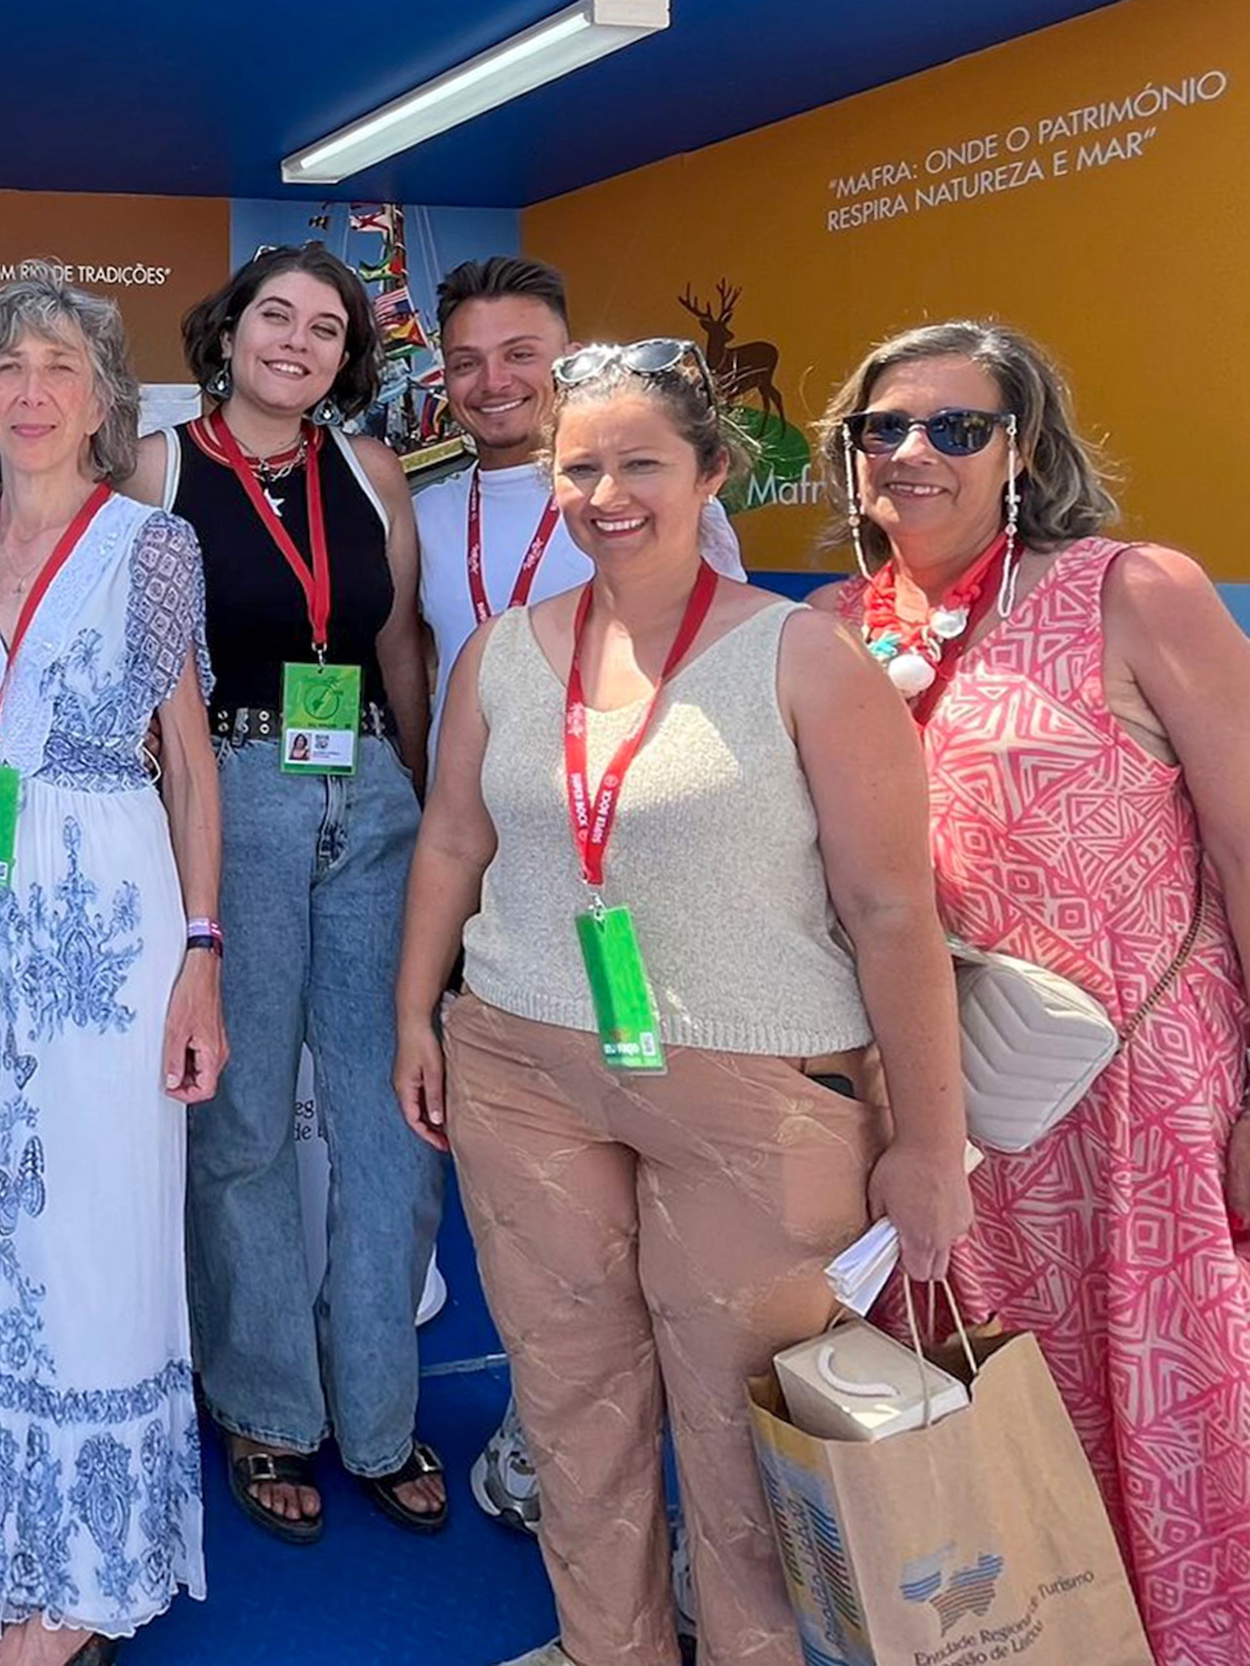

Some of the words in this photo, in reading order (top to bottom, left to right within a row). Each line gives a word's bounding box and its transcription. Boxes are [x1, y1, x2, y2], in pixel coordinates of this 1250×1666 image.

[828, 161, 918, 199] “MAFRA:
[925, 134, 999, 175] ONDE
[1006, 126, 1031, 152] O
[1038, 70, 1228, 145] PATRIMÓNIO
[827, 194, 909, 232] RESPIRA
[915, 158, 1045, 211] NATUREZA
[1053, 150, 1069, 177] E
[53, 264, 75, 283] DE
